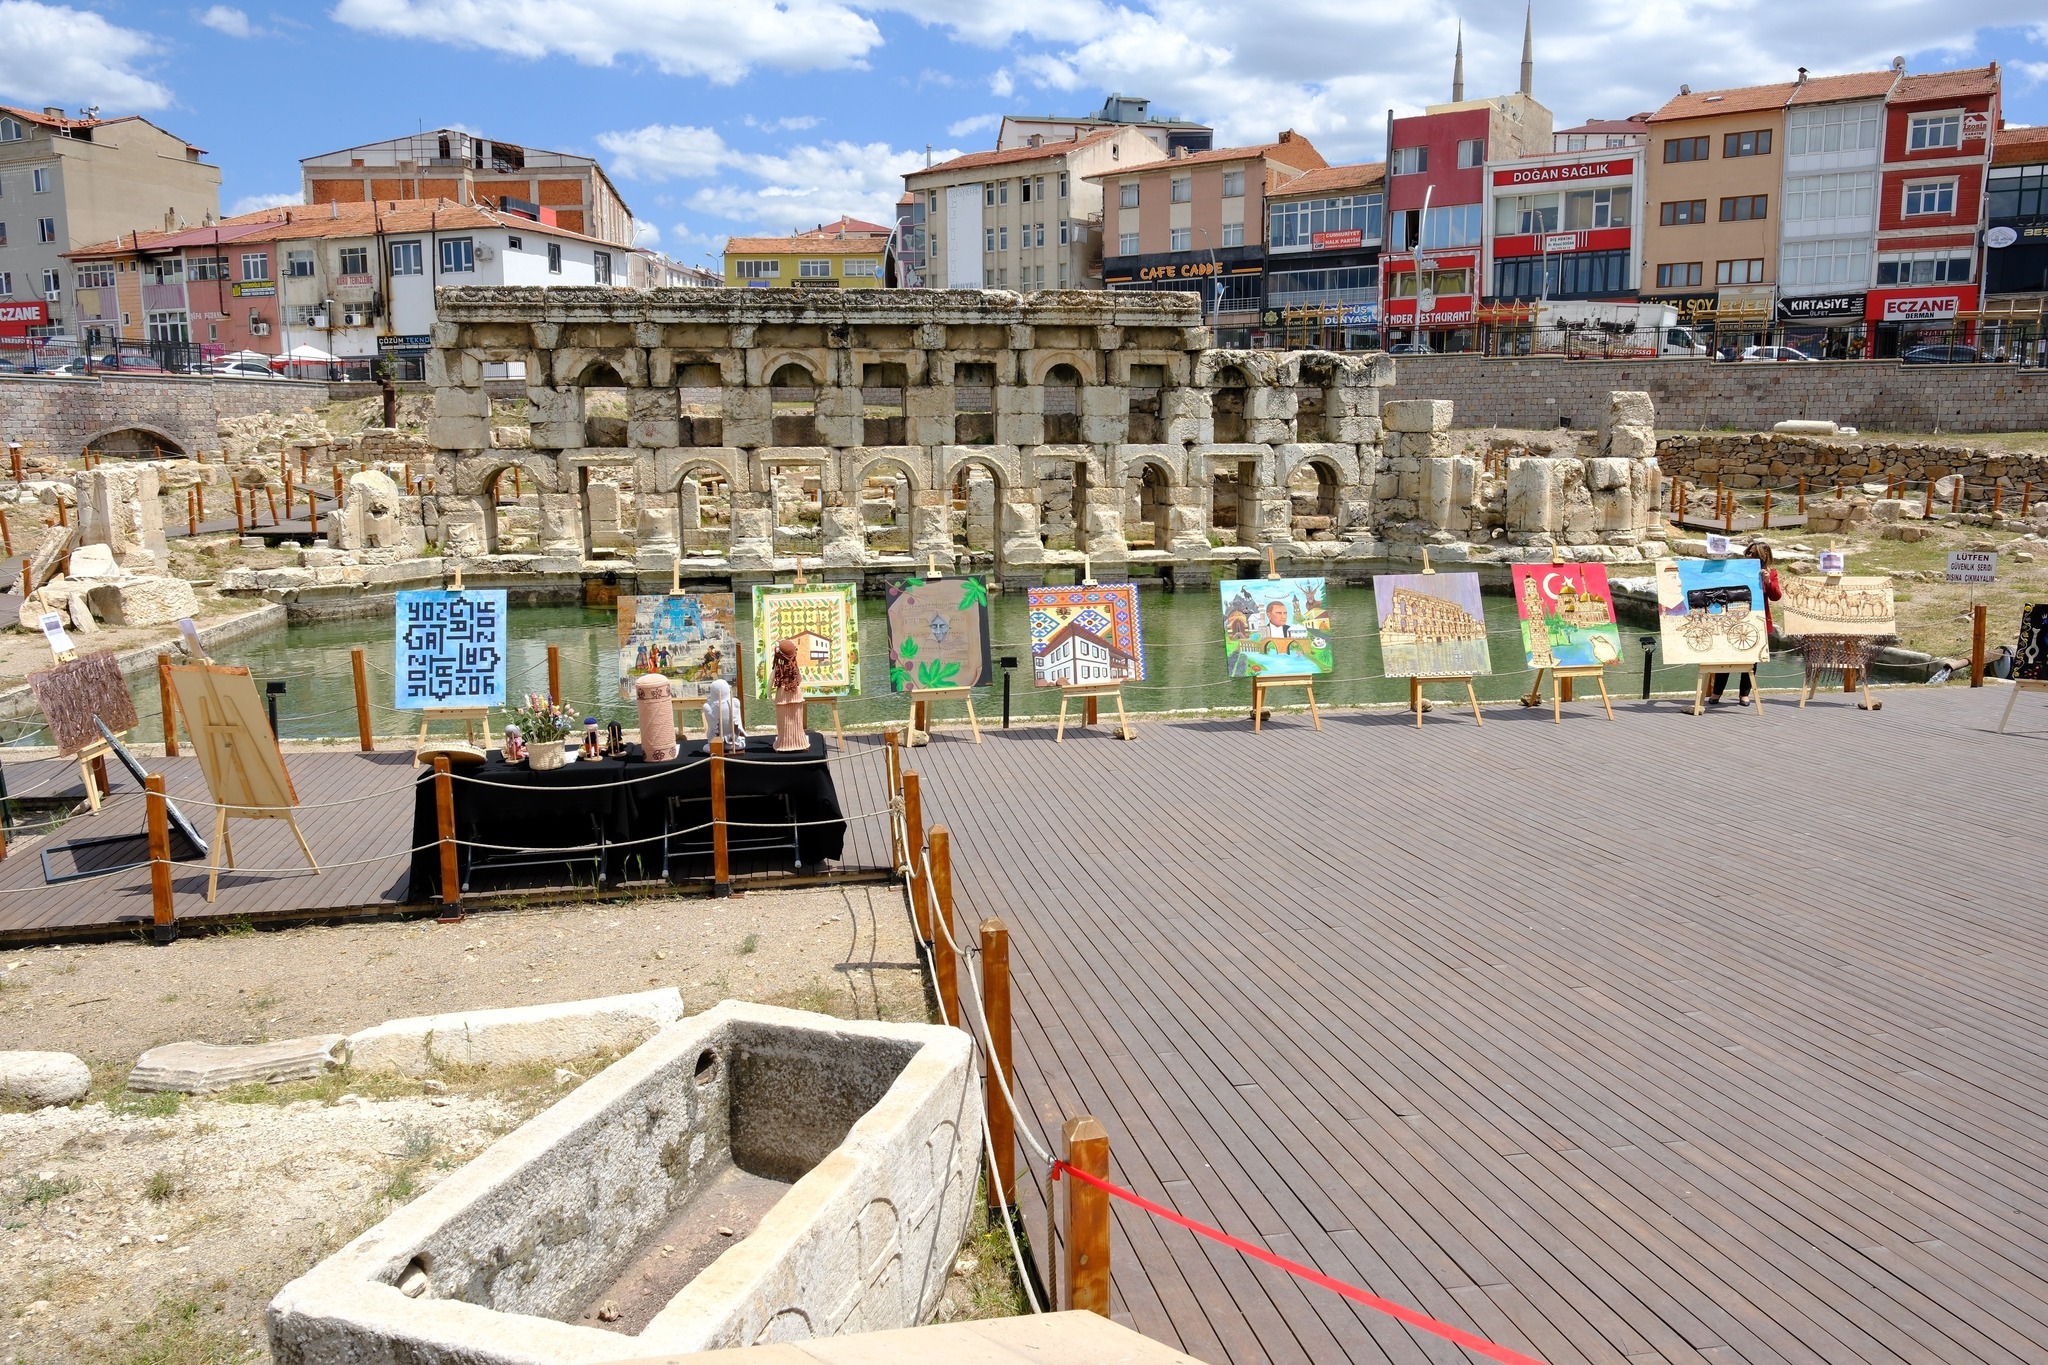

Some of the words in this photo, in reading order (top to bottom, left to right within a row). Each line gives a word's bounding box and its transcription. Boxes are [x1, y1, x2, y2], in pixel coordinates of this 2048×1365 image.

[1513, 169, 1558, 182] DOĞAN
[1561, 163, 1608, 178] SAĞLIK
[1140, 265, 1176, 280] CAFE
[1181, 261, 1223, 277] CADDE
[1887, 299, 1954, 313] ECZANE
[1416, 311, 1470, 323] ESTAURANT
[378, 336, 404, 345] ÇÖZÜM
[1956, 552, 1990, 561] LÜTFEN
[1964, 574, 1995, 583] ÇIKMAYALIM
